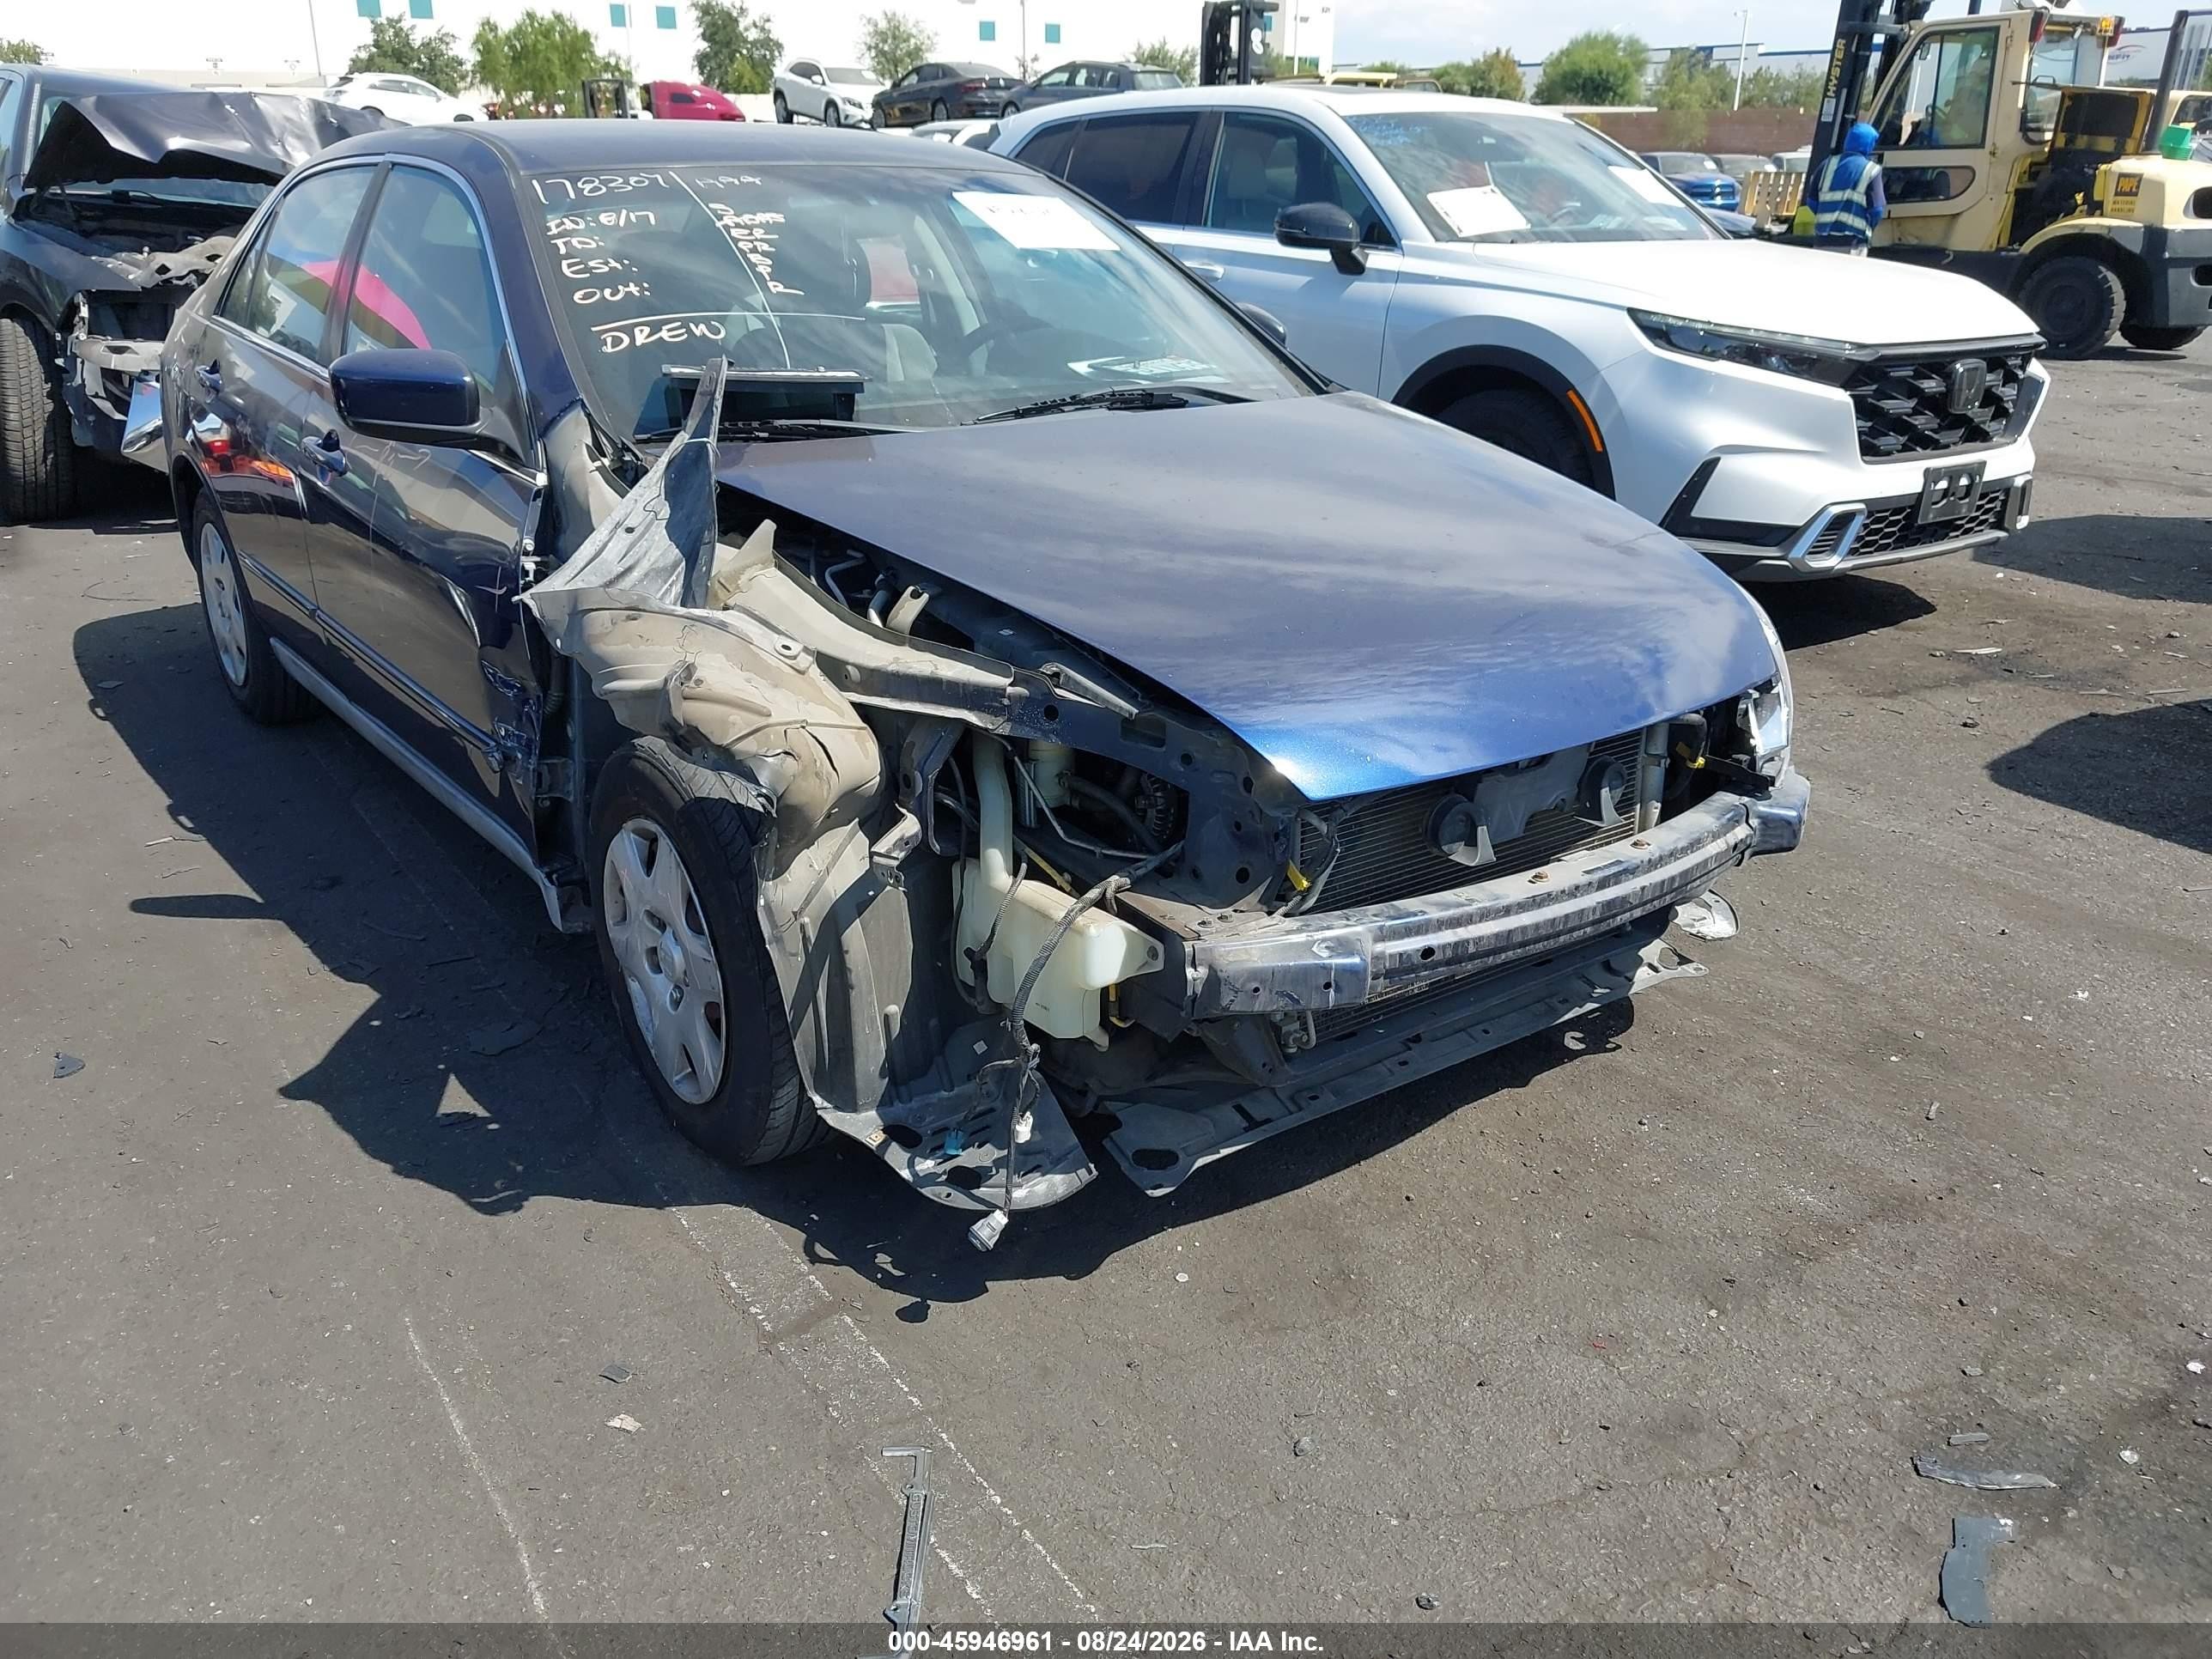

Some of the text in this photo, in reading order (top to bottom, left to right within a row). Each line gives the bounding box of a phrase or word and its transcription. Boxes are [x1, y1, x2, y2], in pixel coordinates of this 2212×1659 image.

[1826, 39, 1846, 97] HYSTER
[532, 172, 670, 205] 178307
[599, 320, 726, 353] DREW
